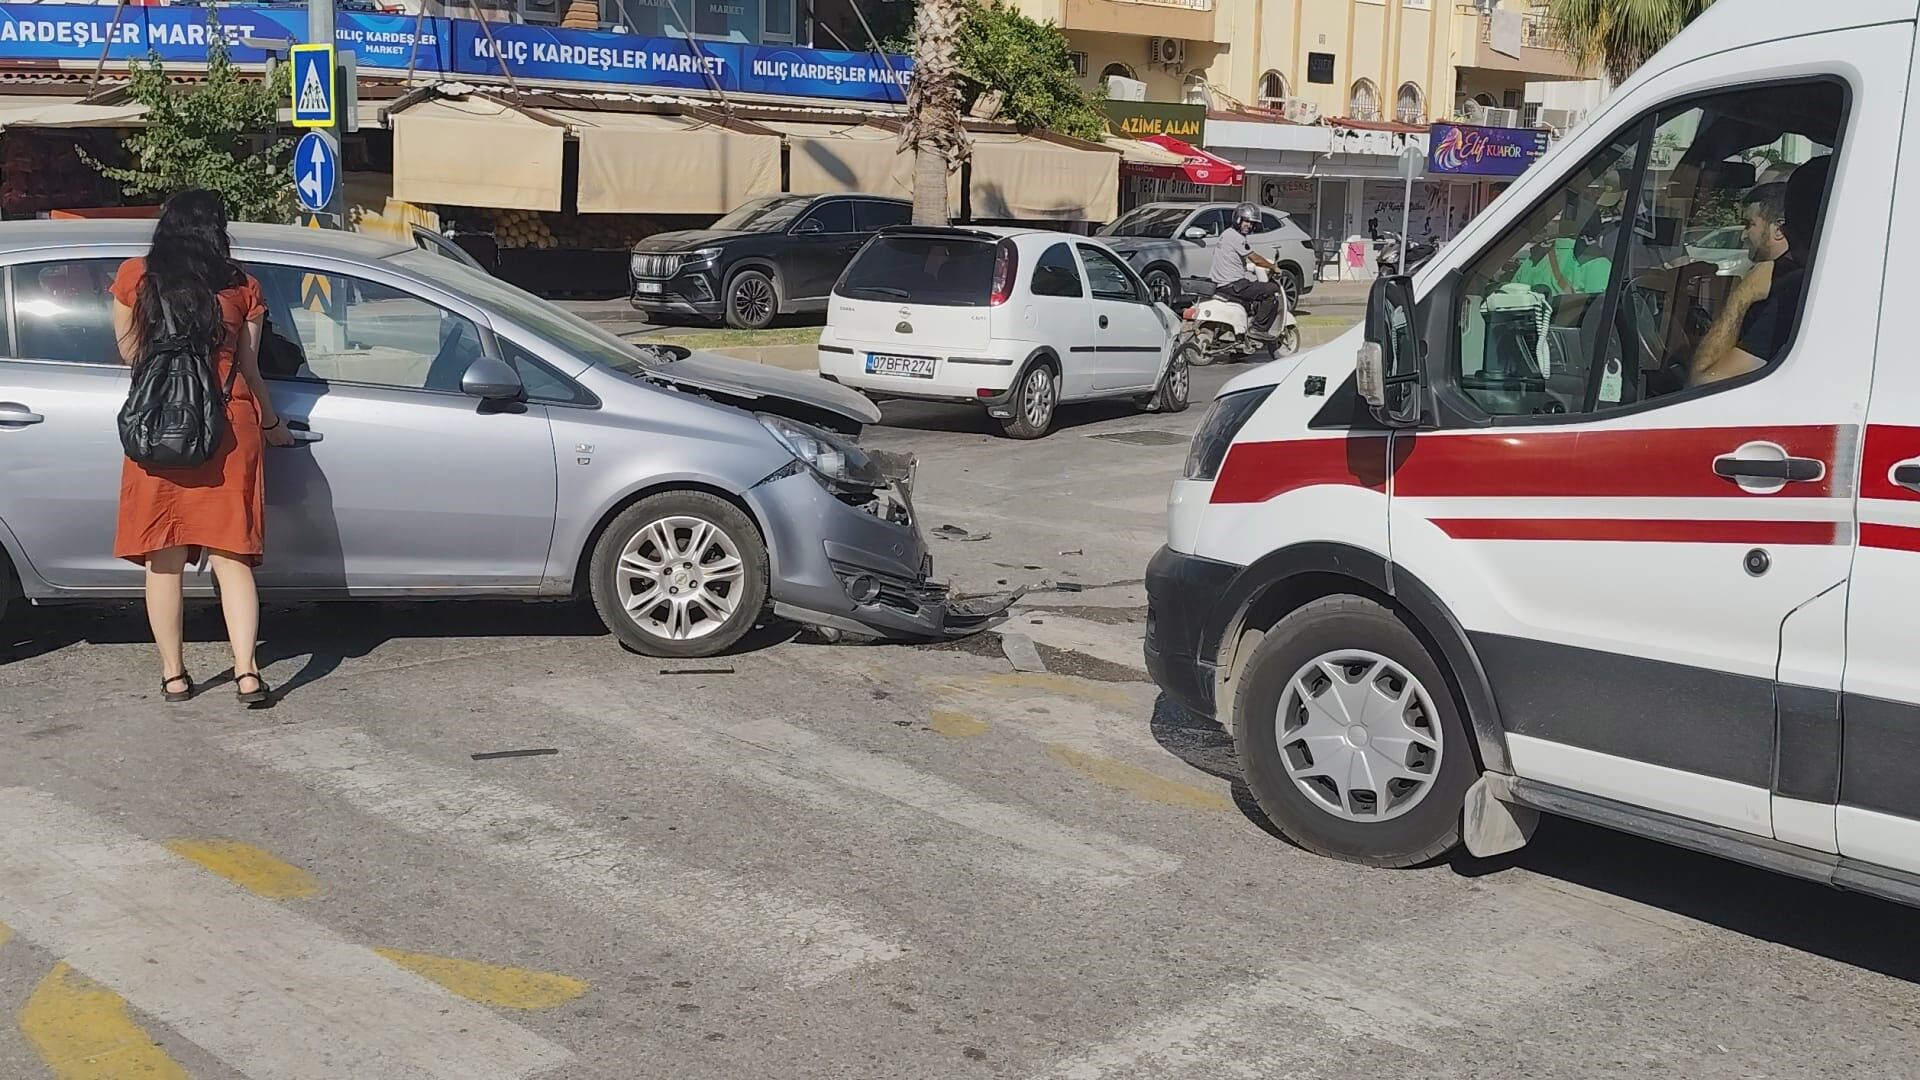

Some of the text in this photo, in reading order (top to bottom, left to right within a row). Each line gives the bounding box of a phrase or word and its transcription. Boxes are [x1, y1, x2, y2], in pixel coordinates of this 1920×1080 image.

[709, 4, 745, 15] MARKET
[366, 31, 437, 47] KARDEŞER
[365, 44, 405, 55] MARKET
[474, 37, 725, 76] KILIÇ KARDEŞLER MARKET
[753, 60, 914, 85] KILIÇ KARDEŞLER MARKE
[1121, 115, 1161, 134] AZİME
[1164, 120, 1200, 135] ALAN
[1460, 132, 1521, 163] Elif KUAFÖR
